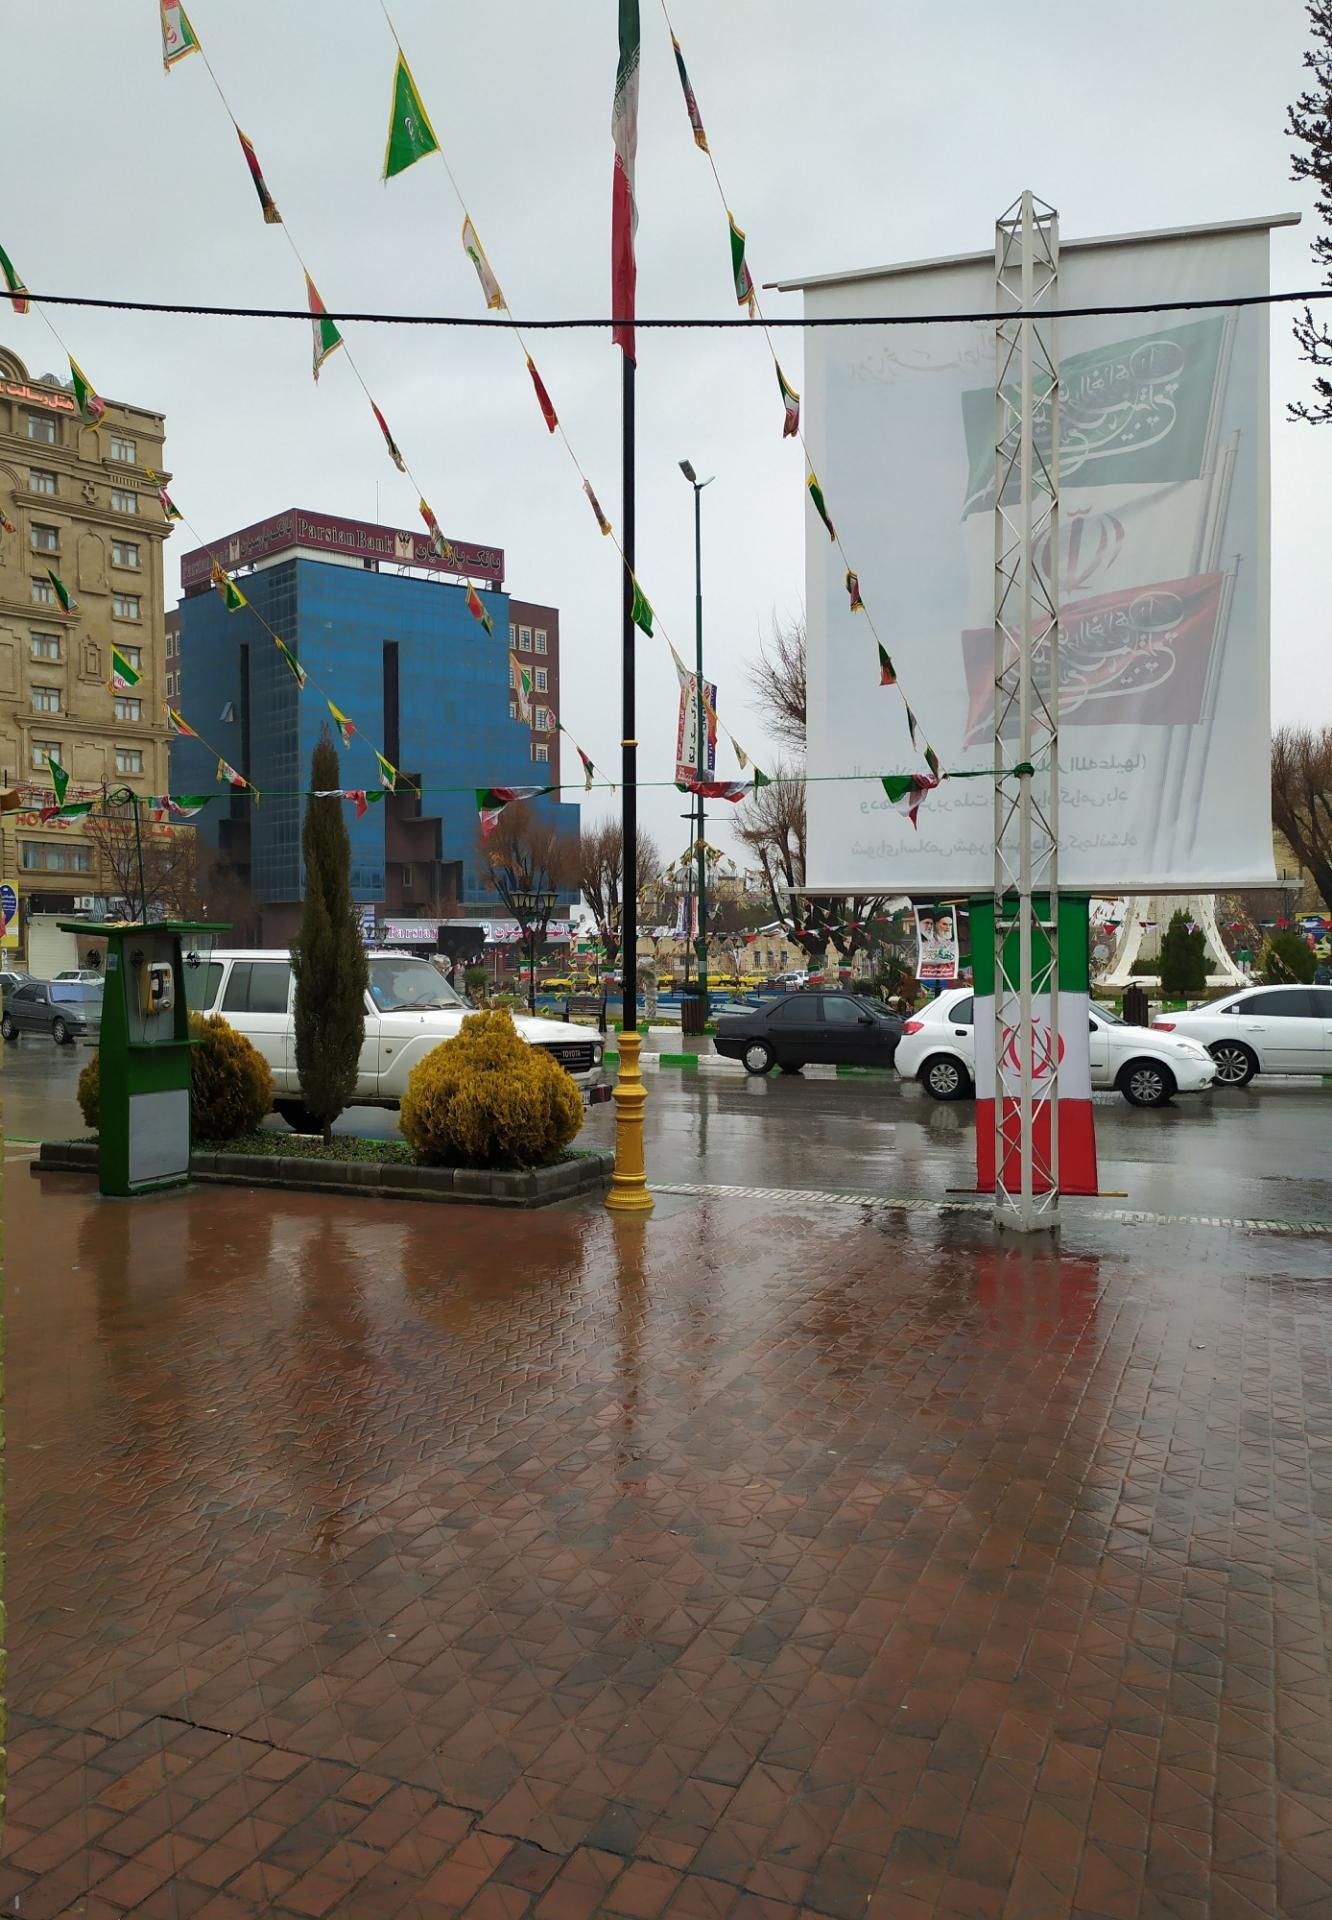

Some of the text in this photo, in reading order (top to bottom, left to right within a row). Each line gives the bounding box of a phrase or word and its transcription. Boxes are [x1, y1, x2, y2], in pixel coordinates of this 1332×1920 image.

[7, 384, 49, 404] رسالت
[48, 394, 74, 410] هتل
[298, 517, 394, 554] Parsian Bank
[466, 550, 500, 575] بانک
[388, 926, 439, 939] Parsian
[562, 1049, 581, 1058] TOYOTA
